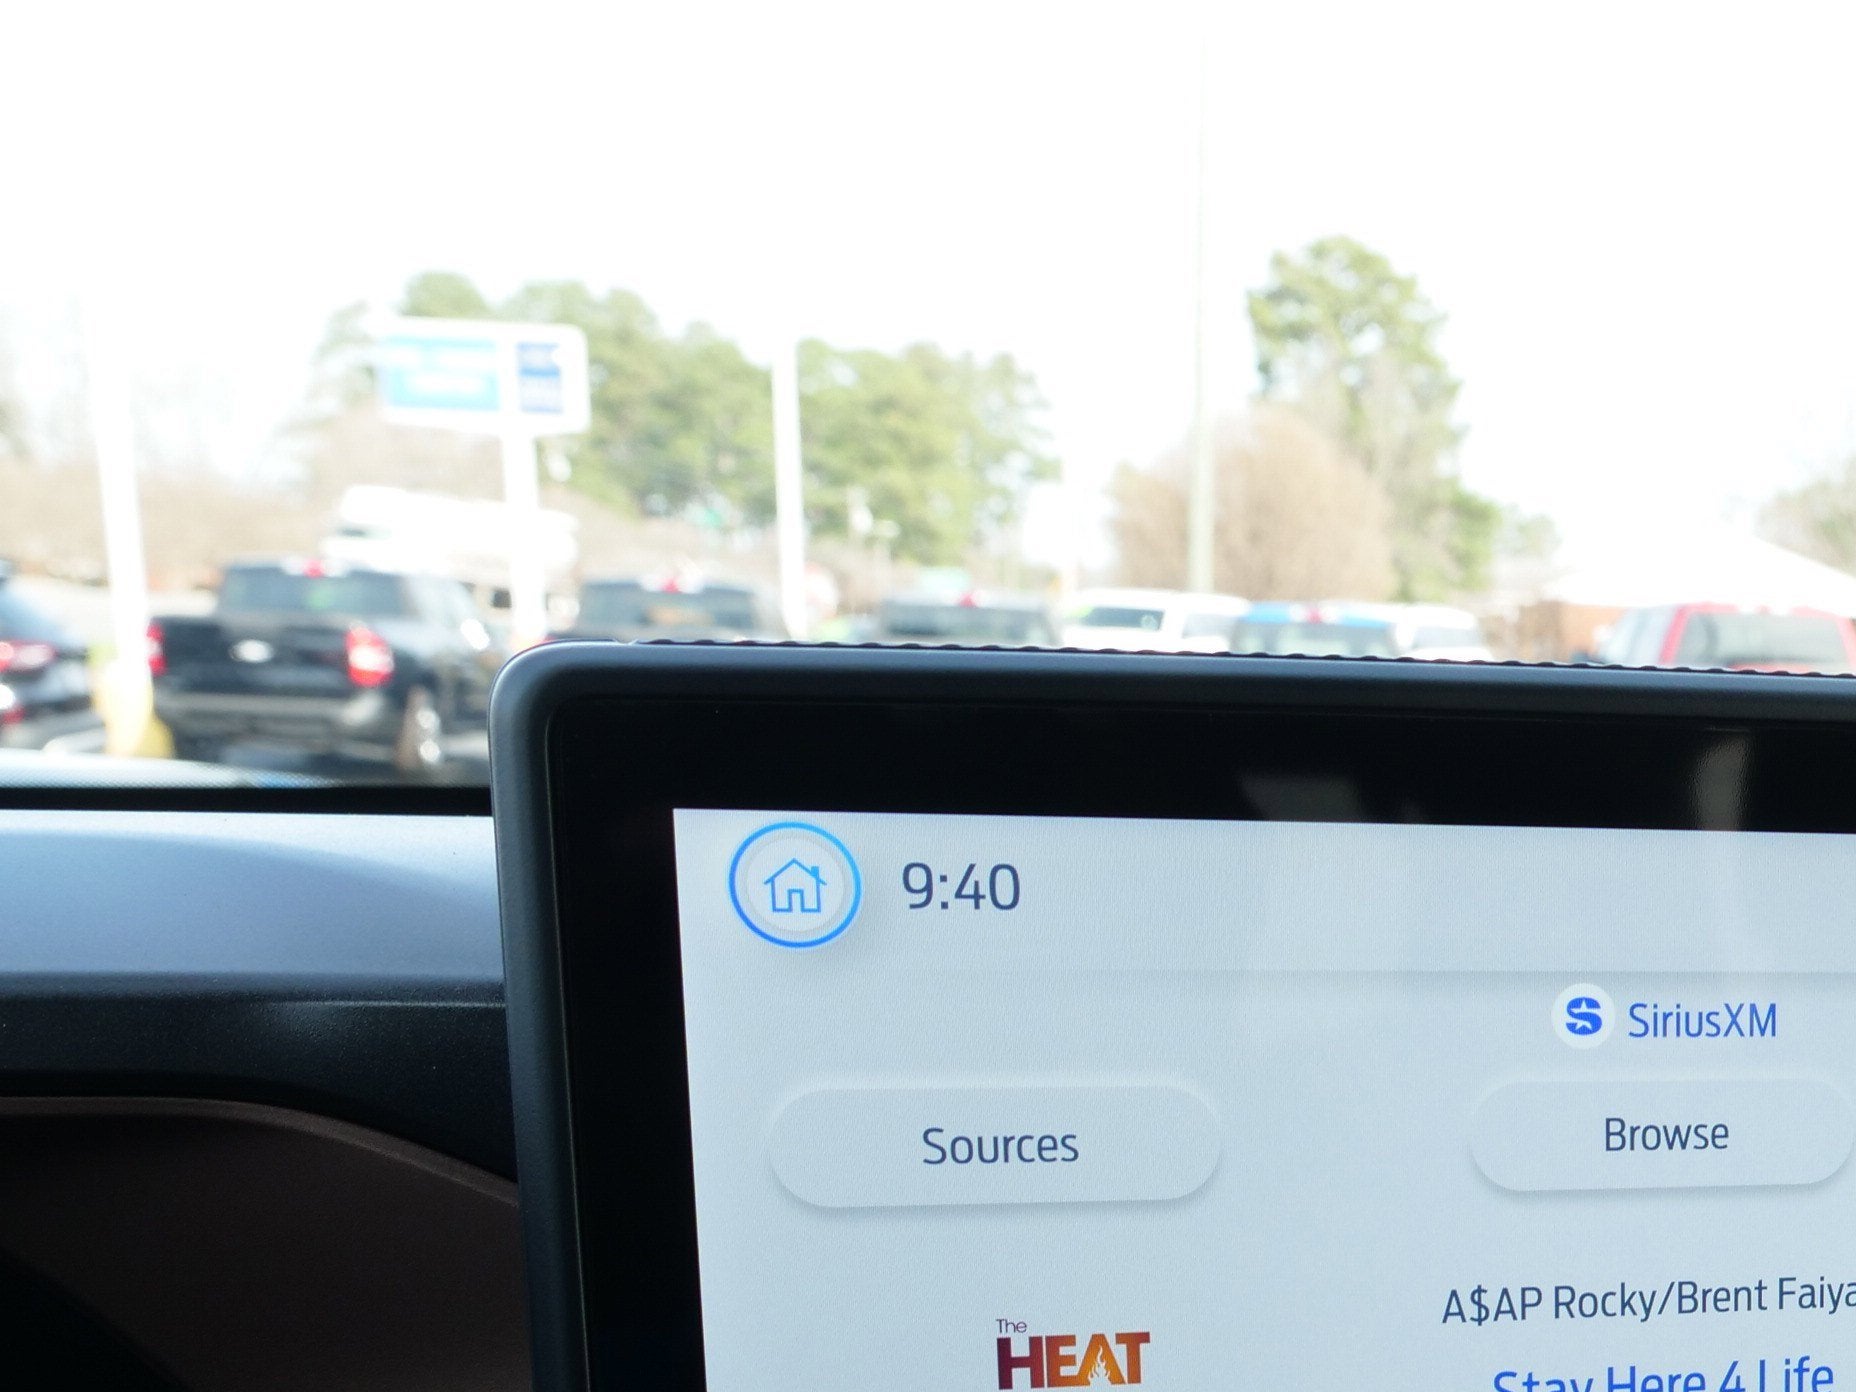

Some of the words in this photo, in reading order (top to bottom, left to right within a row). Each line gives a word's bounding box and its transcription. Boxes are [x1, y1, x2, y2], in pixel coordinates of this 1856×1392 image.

[901, 861, 1021, 911] 9:40
[1628, 1002, 1778, 1039] SiriusXM
[921, 1126, 1080, 1165] Sources
[1603, 1116, 1730, 1152] Browse
[1441, 1283, 1544, 1327] A$AP
[1553, 1278, 1769, 1324] Rocky/Brent
[996, 1318, 1028, 1334] The
[996, 1332, 1151, 1391] HEAT
